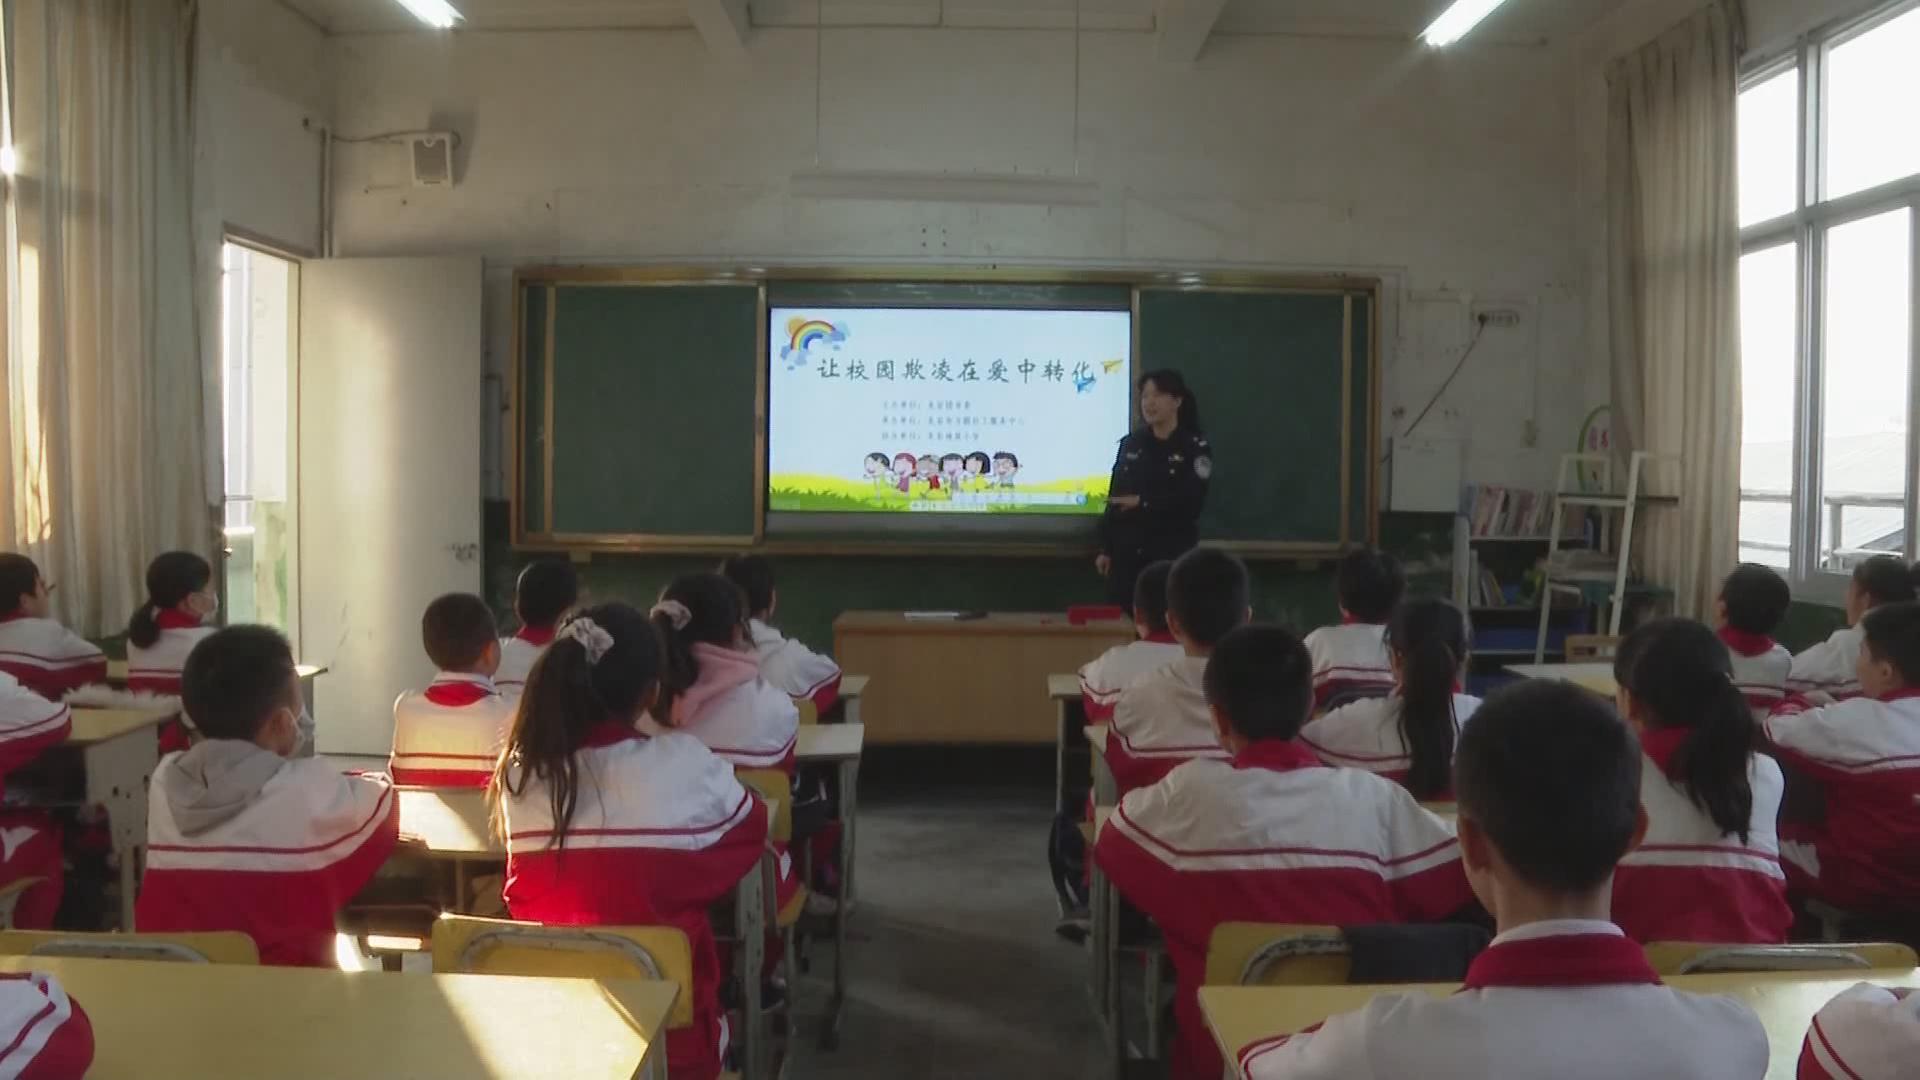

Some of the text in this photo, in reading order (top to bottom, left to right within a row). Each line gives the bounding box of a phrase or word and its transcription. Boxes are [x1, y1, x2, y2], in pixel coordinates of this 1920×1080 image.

[817, 358, 1096, 385] 让校园欺凌在爱中转化
